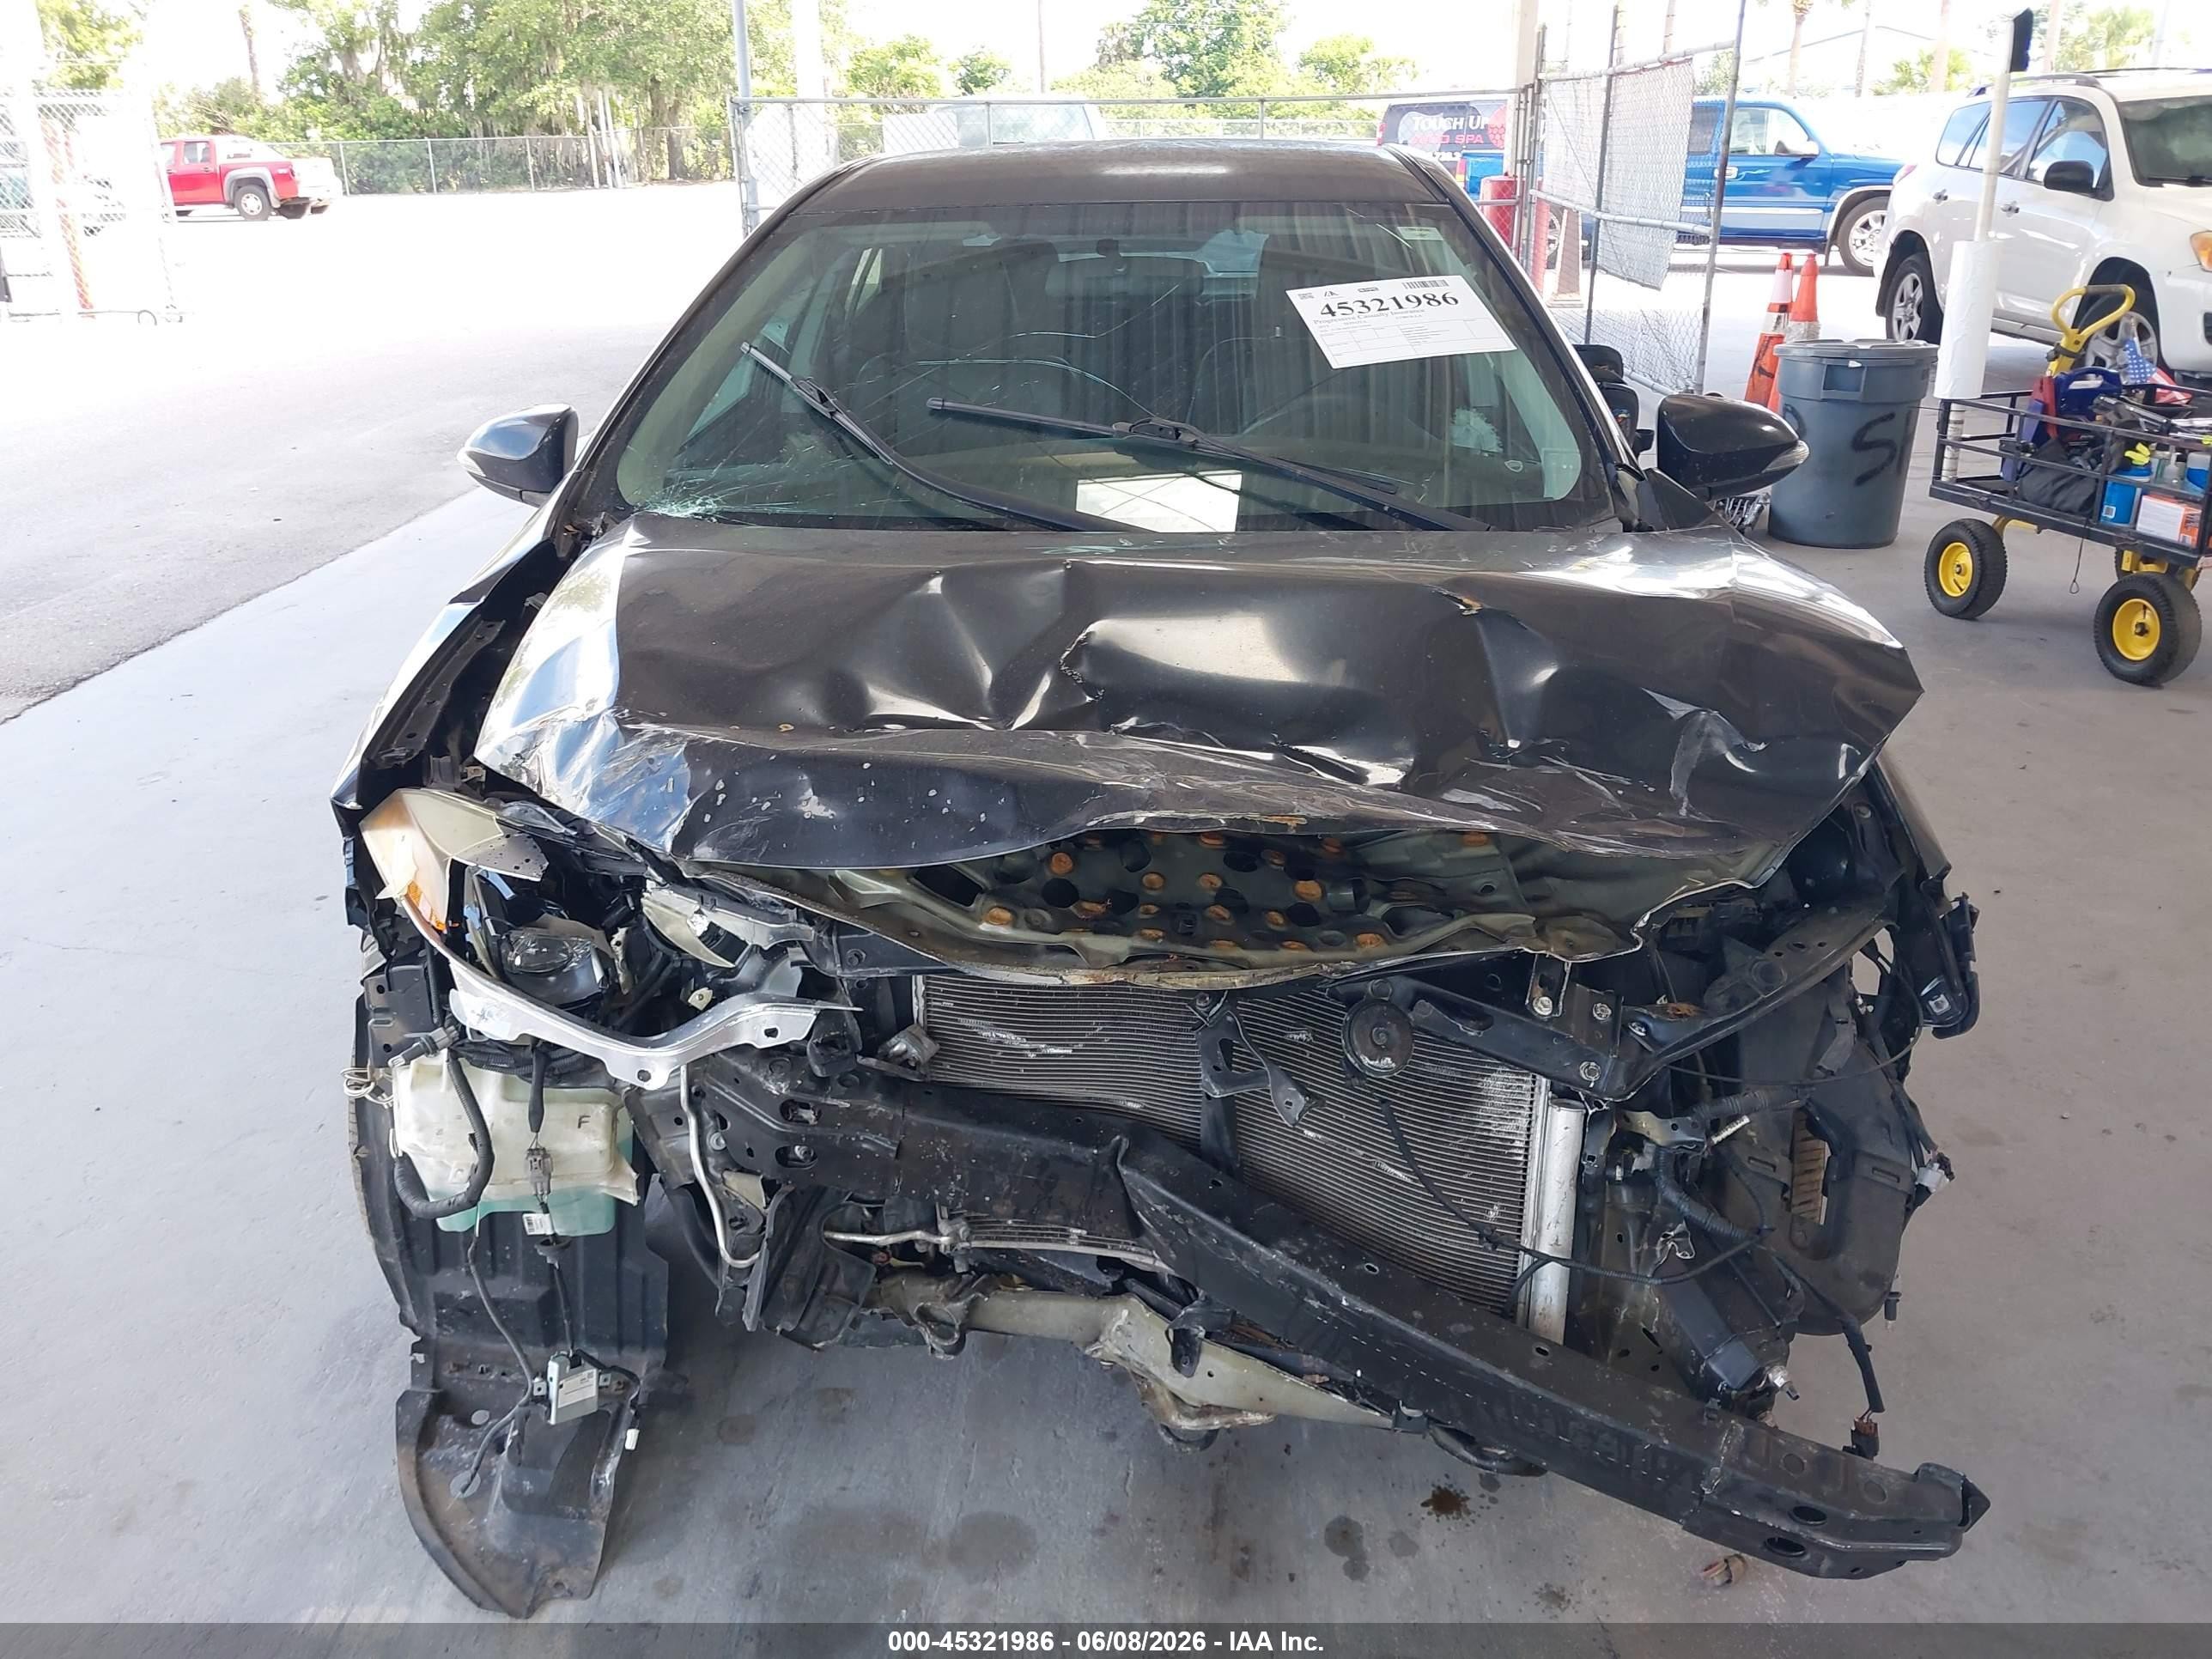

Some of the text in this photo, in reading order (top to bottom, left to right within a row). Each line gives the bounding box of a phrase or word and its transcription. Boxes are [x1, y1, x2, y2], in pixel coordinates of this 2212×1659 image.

[1455, 134, 1485, 144] SPA
[1320, 291, 1460, 318] 45321986
[577, 1115, 592, 1129] F
